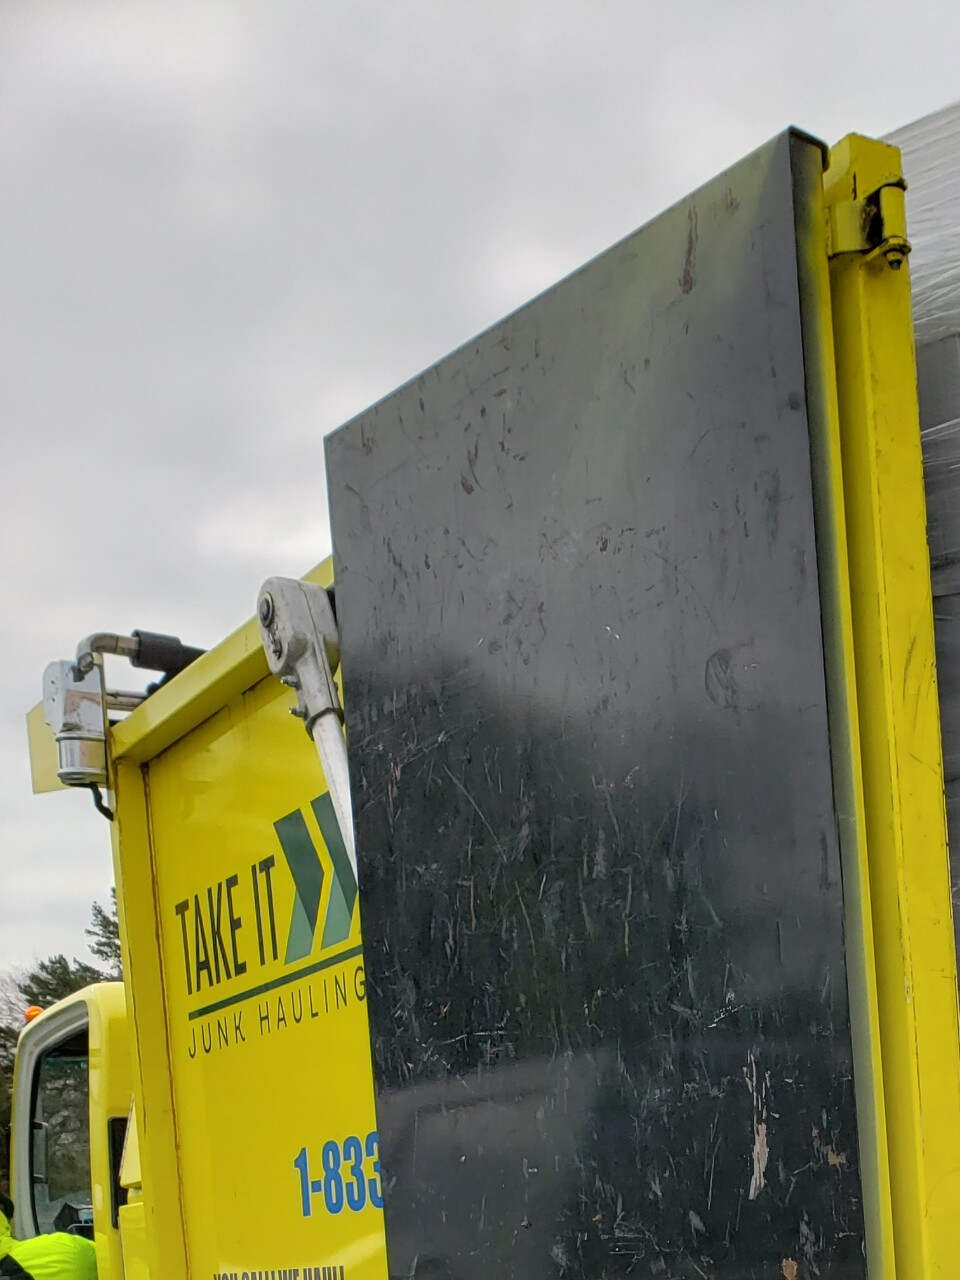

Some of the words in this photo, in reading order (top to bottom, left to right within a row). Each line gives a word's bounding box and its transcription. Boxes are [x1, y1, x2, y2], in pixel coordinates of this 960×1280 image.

[175, 873, 247, 995] TAKE
[251, 854, 279, 967] IT
[188, 1010, 246, 1060] JUNK
[258, 965, 367, 1036] HAULING
